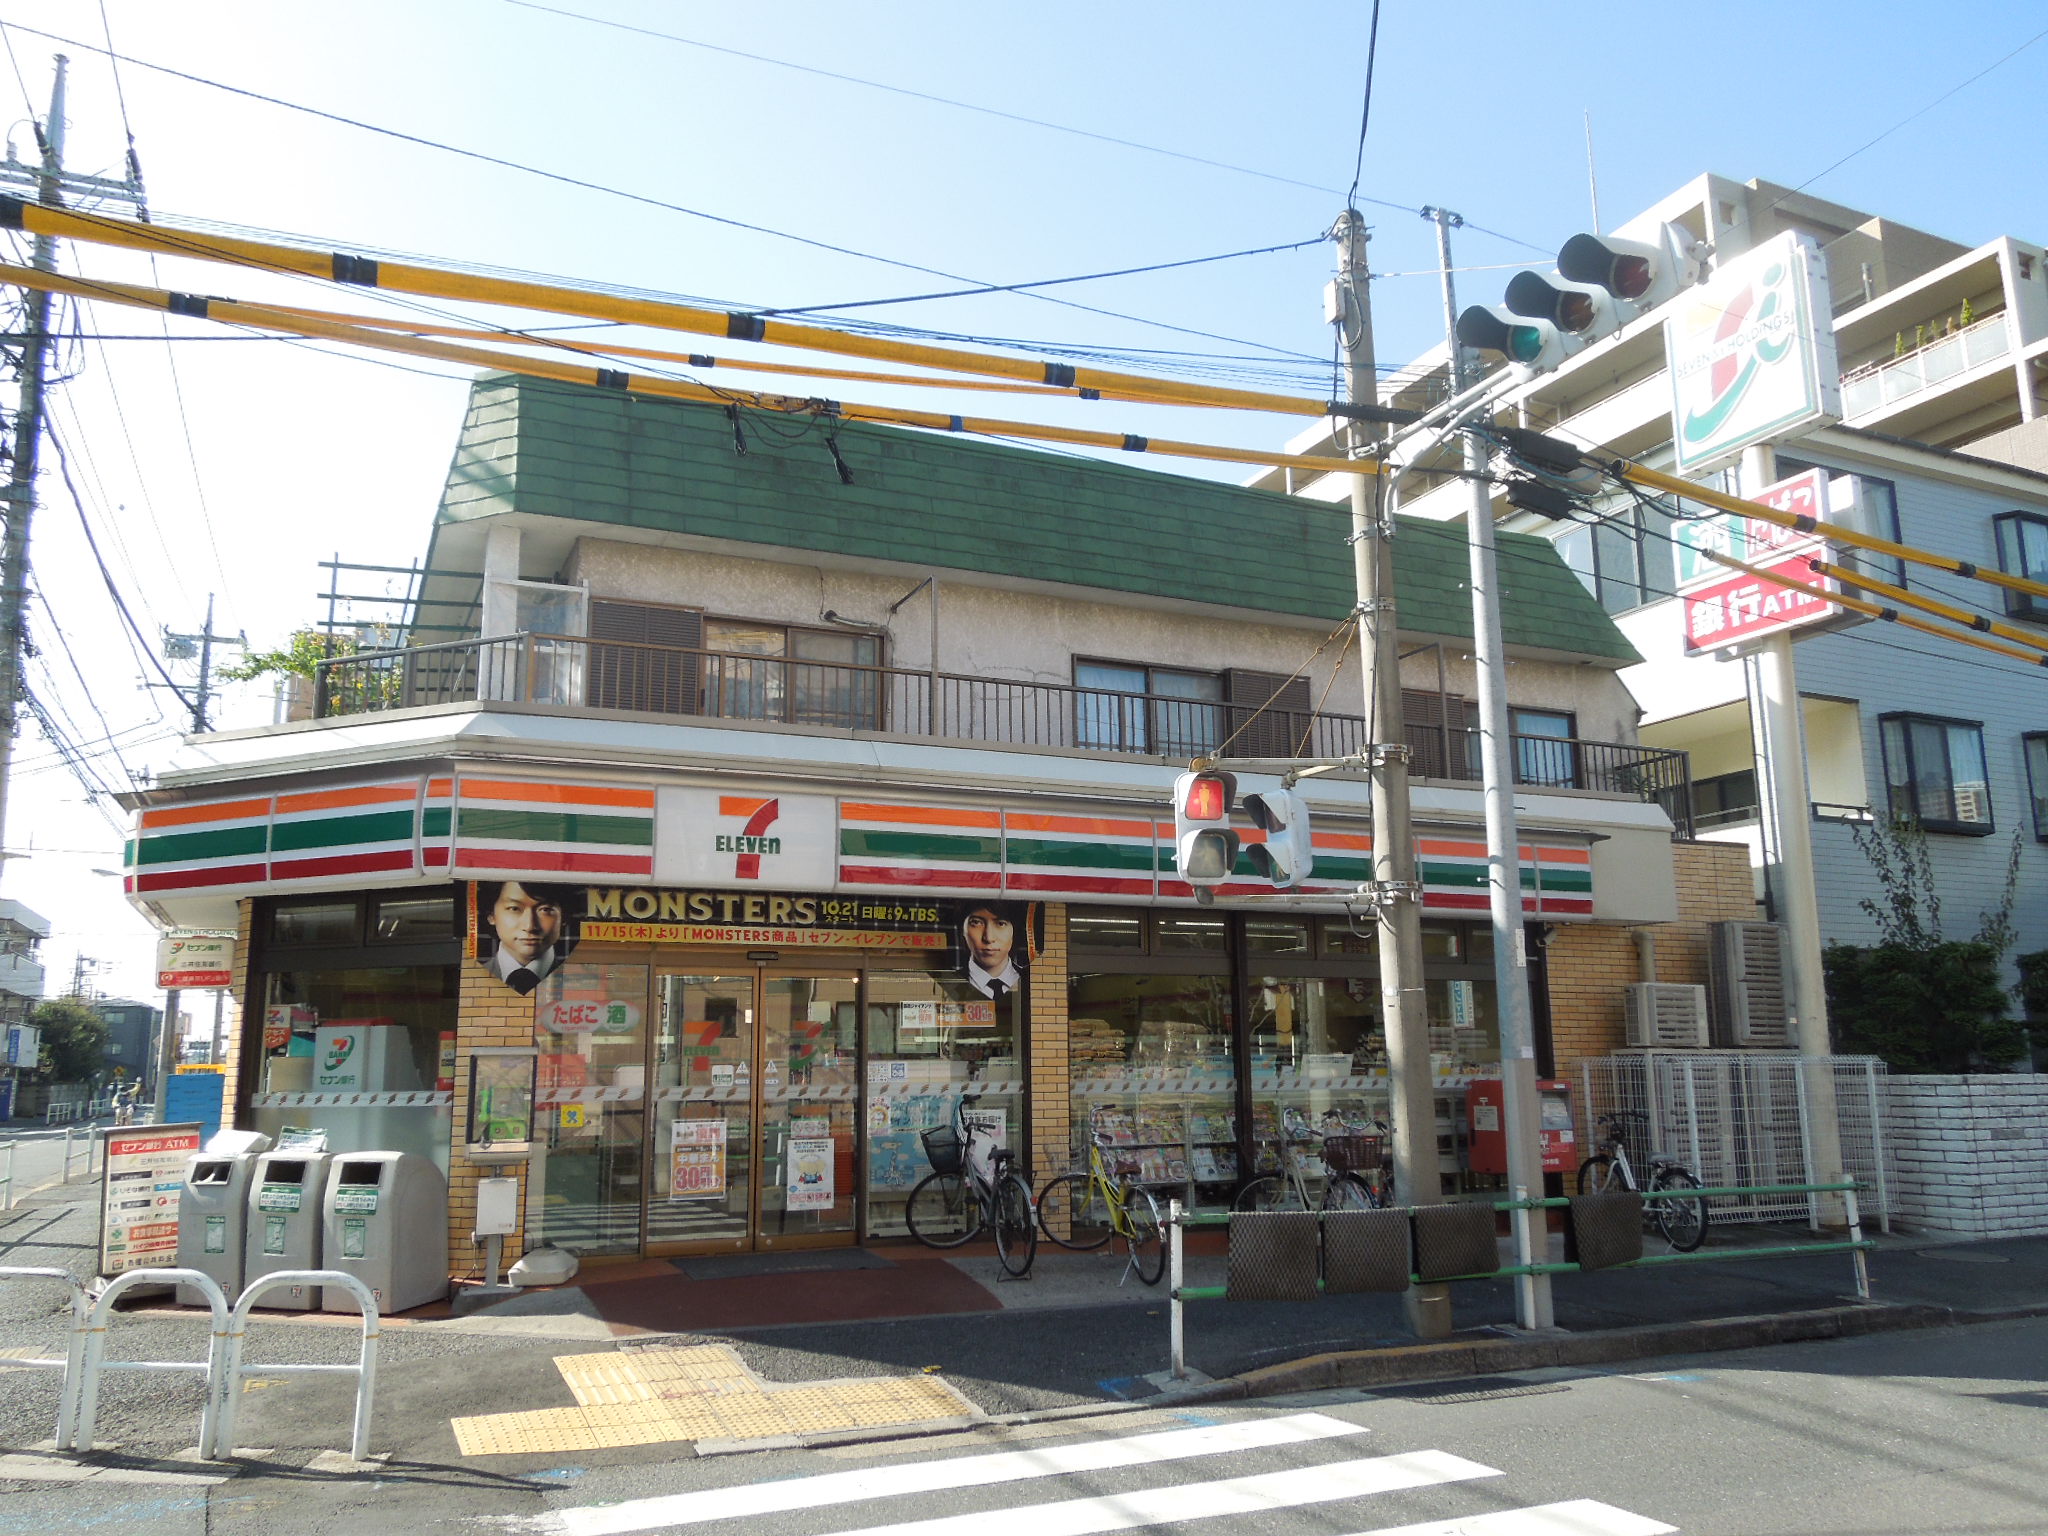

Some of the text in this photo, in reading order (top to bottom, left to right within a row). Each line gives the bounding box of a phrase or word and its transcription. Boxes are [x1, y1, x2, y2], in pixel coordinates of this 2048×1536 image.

[587, 888, 817, 925] MONSTERS
[822, 900, 858, 916] 10.21
[826, 914, 855, 923] スタート
[552, 1004, 599, 1024] たばこ
[606, 1004, 627, 1024] 酒
[165, 1139, 190, 1149] ATM
